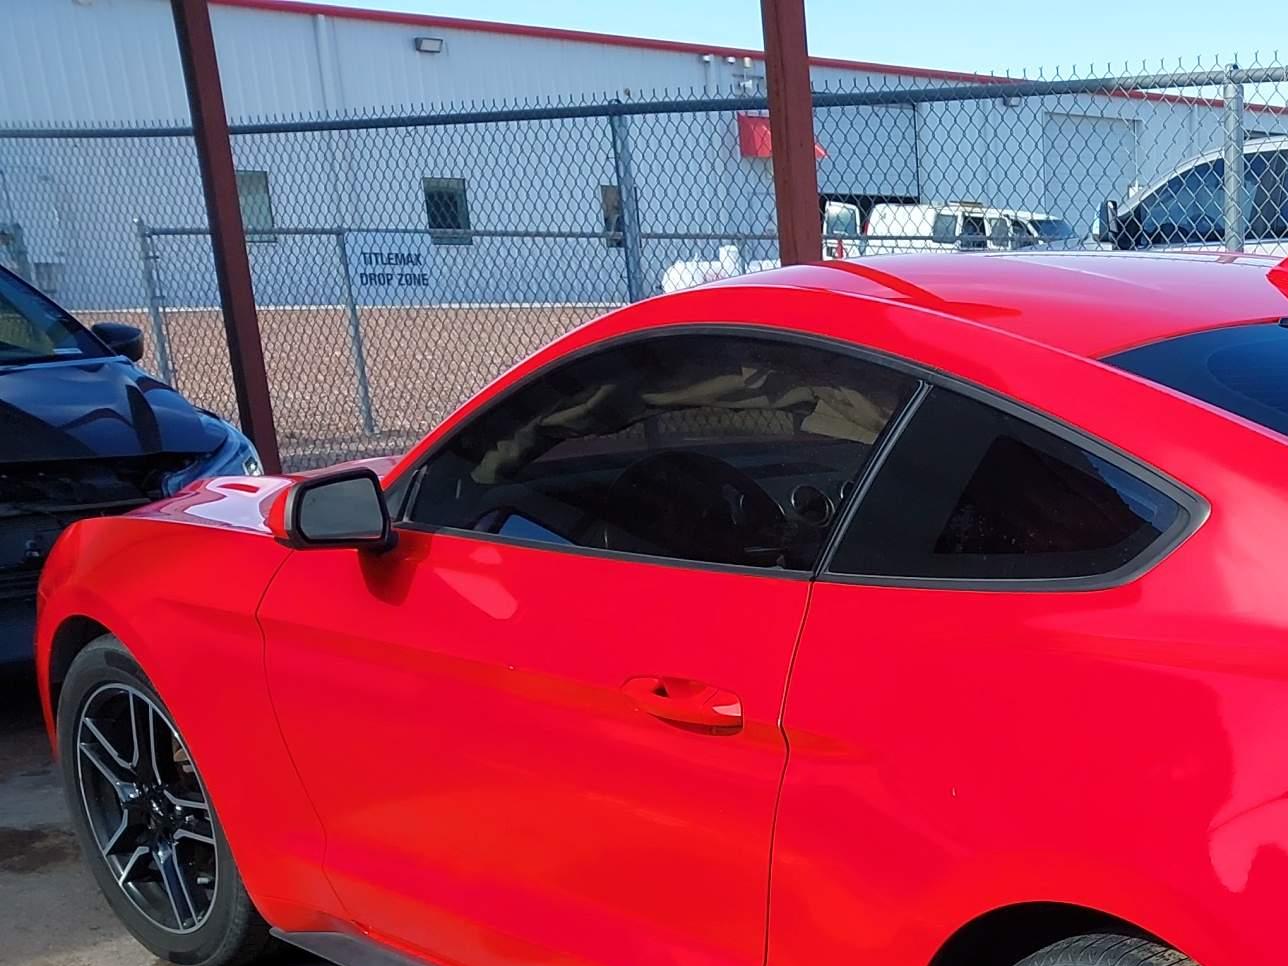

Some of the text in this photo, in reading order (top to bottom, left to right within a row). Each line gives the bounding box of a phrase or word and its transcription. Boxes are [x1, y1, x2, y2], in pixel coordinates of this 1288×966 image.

[361, 252, 423, 266] TITLEMAX
[360, 273, 429, 286] DROP ZONE
